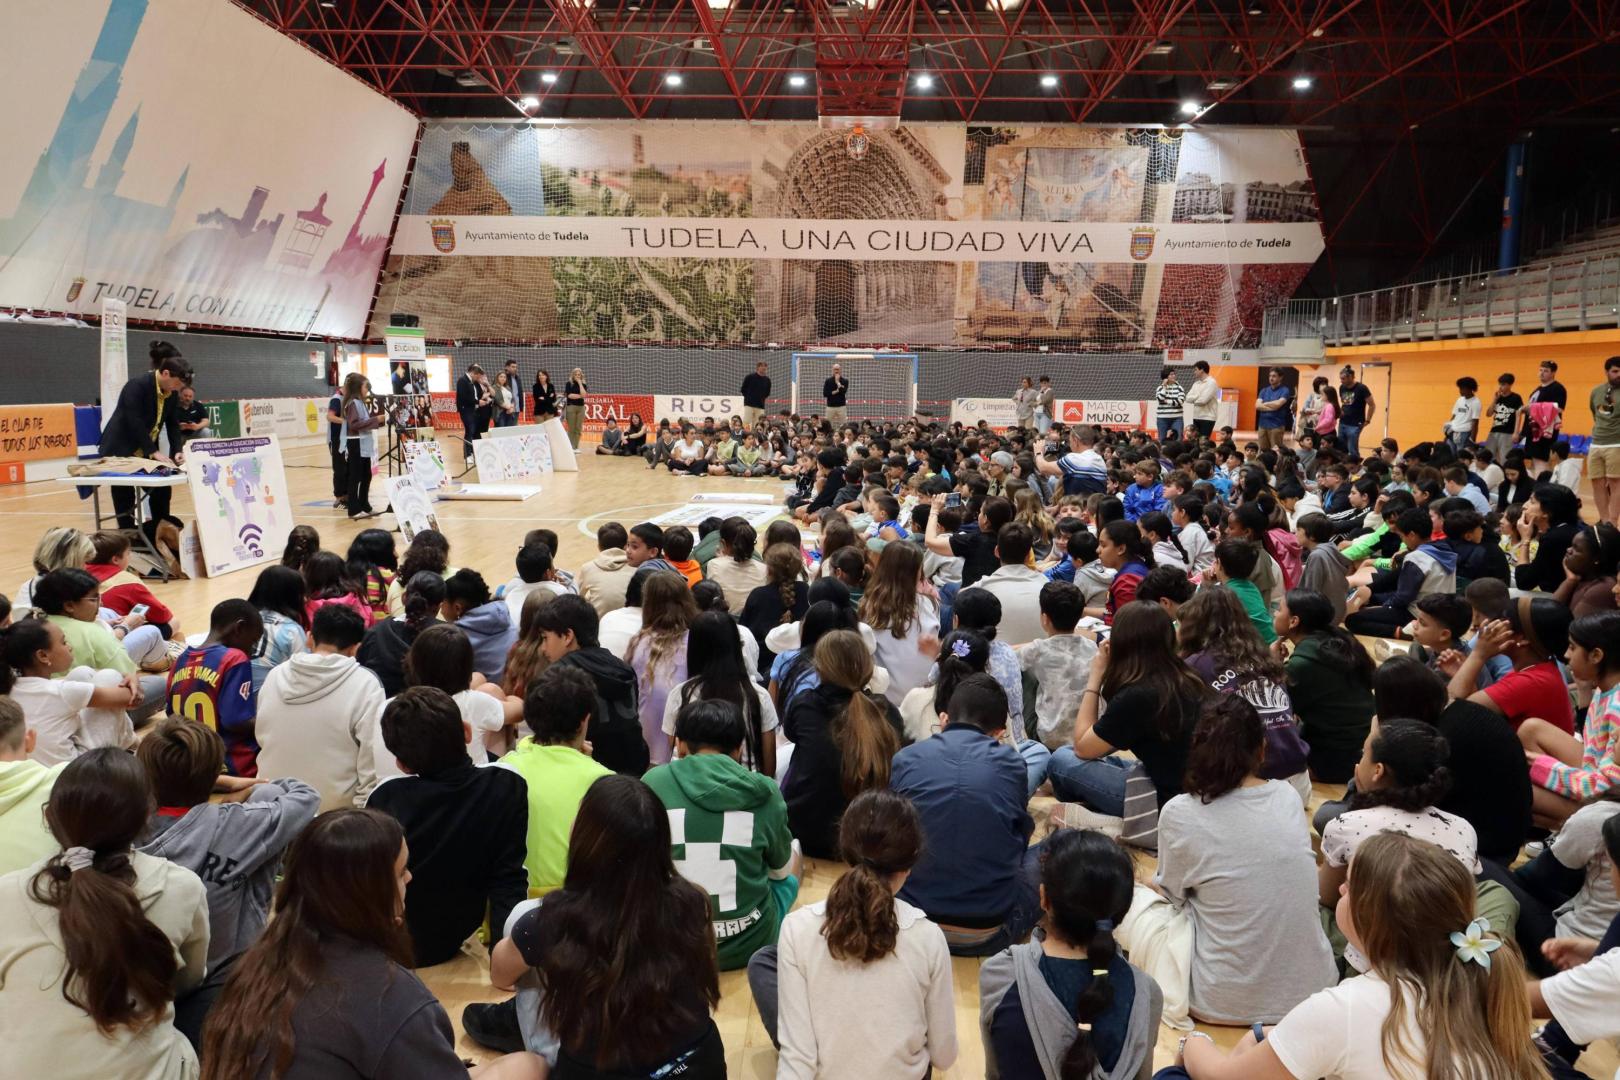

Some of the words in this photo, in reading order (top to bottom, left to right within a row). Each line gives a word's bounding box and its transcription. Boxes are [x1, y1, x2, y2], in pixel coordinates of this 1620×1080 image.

[465, 230, 536, 242] Ayuntamiento
[538, 230, 551, 241] de
[553, 231, 589, 241] Tudela
[621, 227, 767, 251] TUDELA,
[782, 229, 856, 250] UNA
[867, 229, 1005, 252] CIUDAD
[1018, 231, 1094, 253] VIVA
[1164, 238, 1237, 250] Ayuntamiento
[1239, 238, 1253, 249] de
[1256, 238, 1291, 248] Tudela
[186, 294, 230, 316] CON
[1087, 401, 1128, 412] MATEO
[1, 418, 10, 433] EL
[12, 416, 31, 432] CLUB
[33, 417, 43, 430] DE
[1086, 411, 1130, 423] MUÑOZ
[28, 435, 42, 451] LOS
[1211, 669, 1237, 691] ROO
